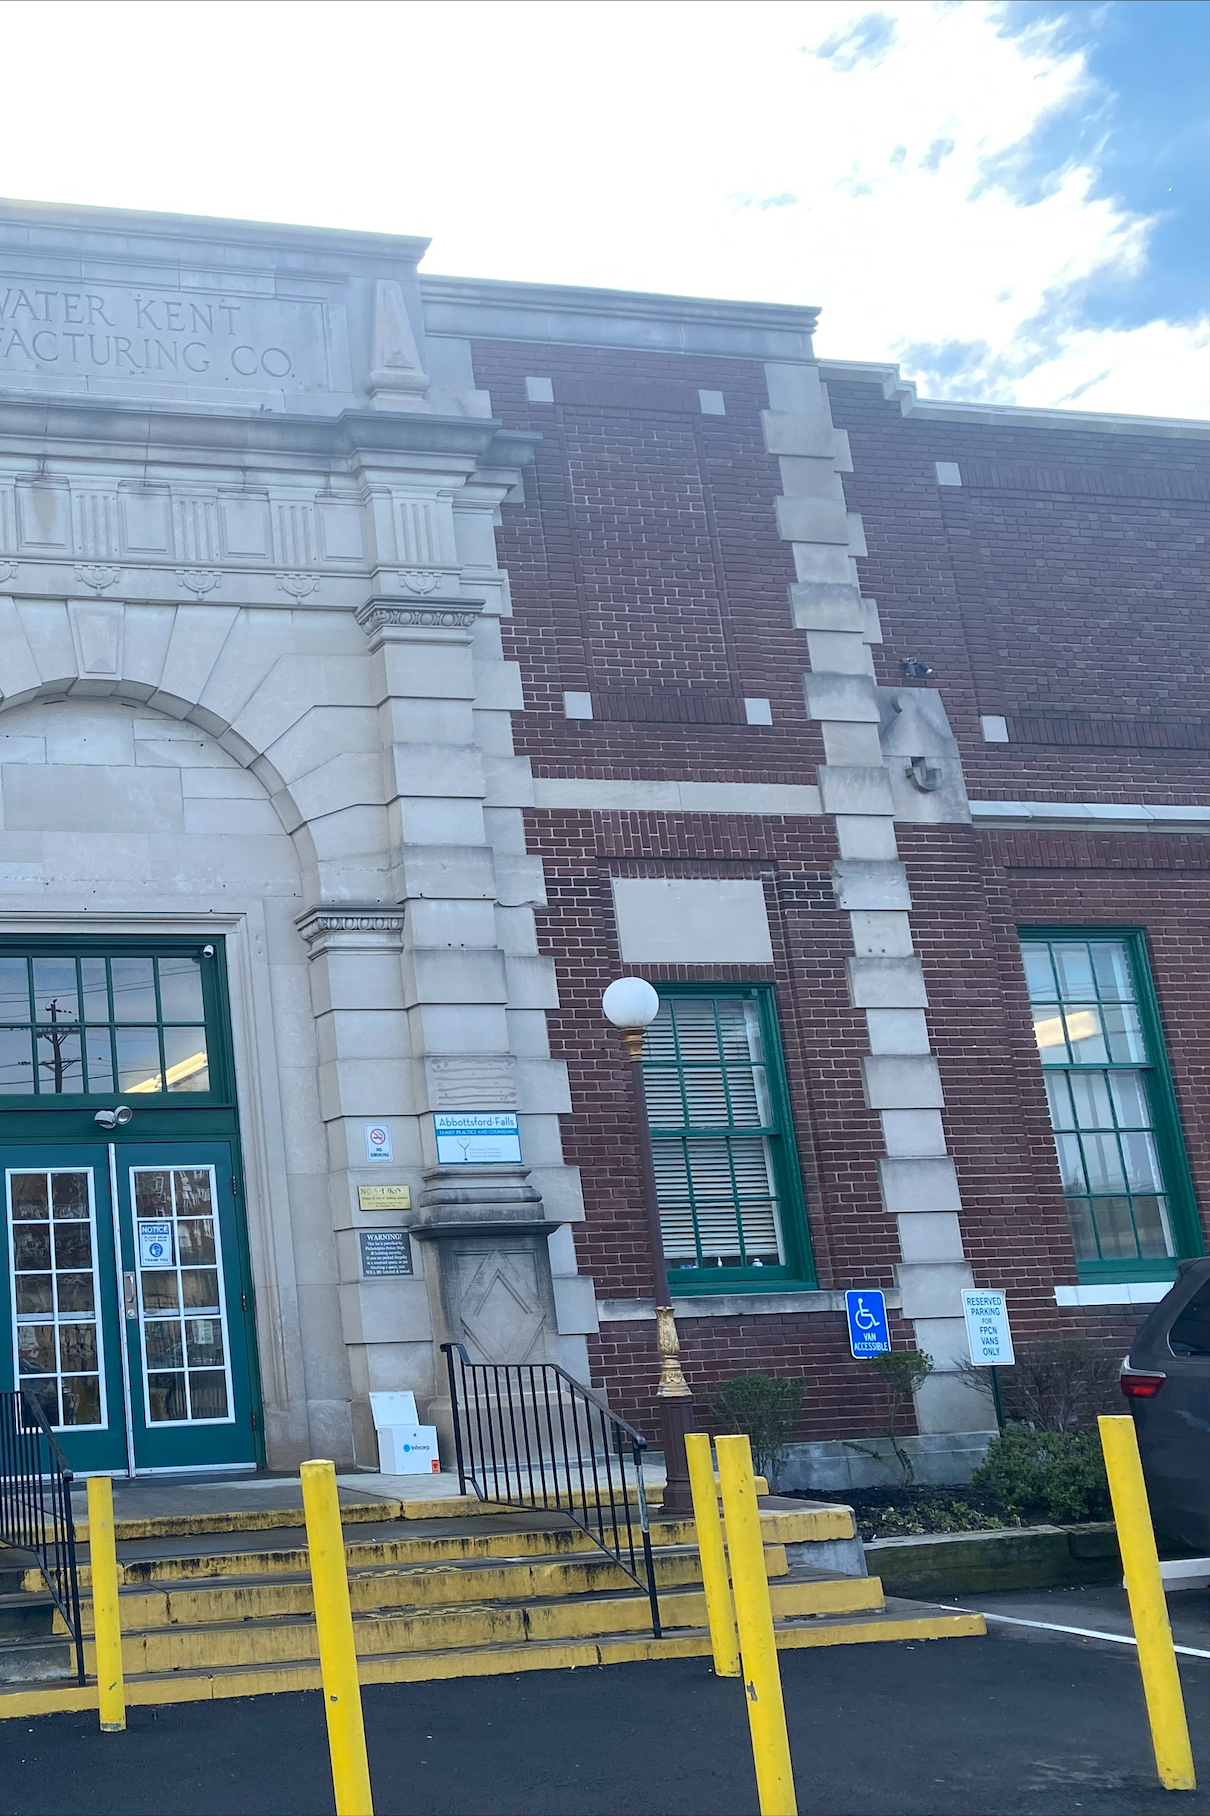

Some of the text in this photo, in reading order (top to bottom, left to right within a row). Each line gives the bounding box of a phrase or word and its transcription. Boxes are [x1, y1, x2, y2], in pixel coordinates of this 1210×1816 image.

[134, 293, 242, 336] KENT
[439, 1116, 514, 1126] Abbottsford-Falls
[966, 1297, 1002, 1306] RESERVED
[971, 1308, 1000, 1316] PARKING
[980, 1326, 998, 1335] FPCN
[863, 1333, 876, 1341] VAN
[981, 1337, 999, 1345] VANS
[854, 1342, 888, 1351] ACCESSIBLE
[982, 1347, 1000, 1356] ONLY
